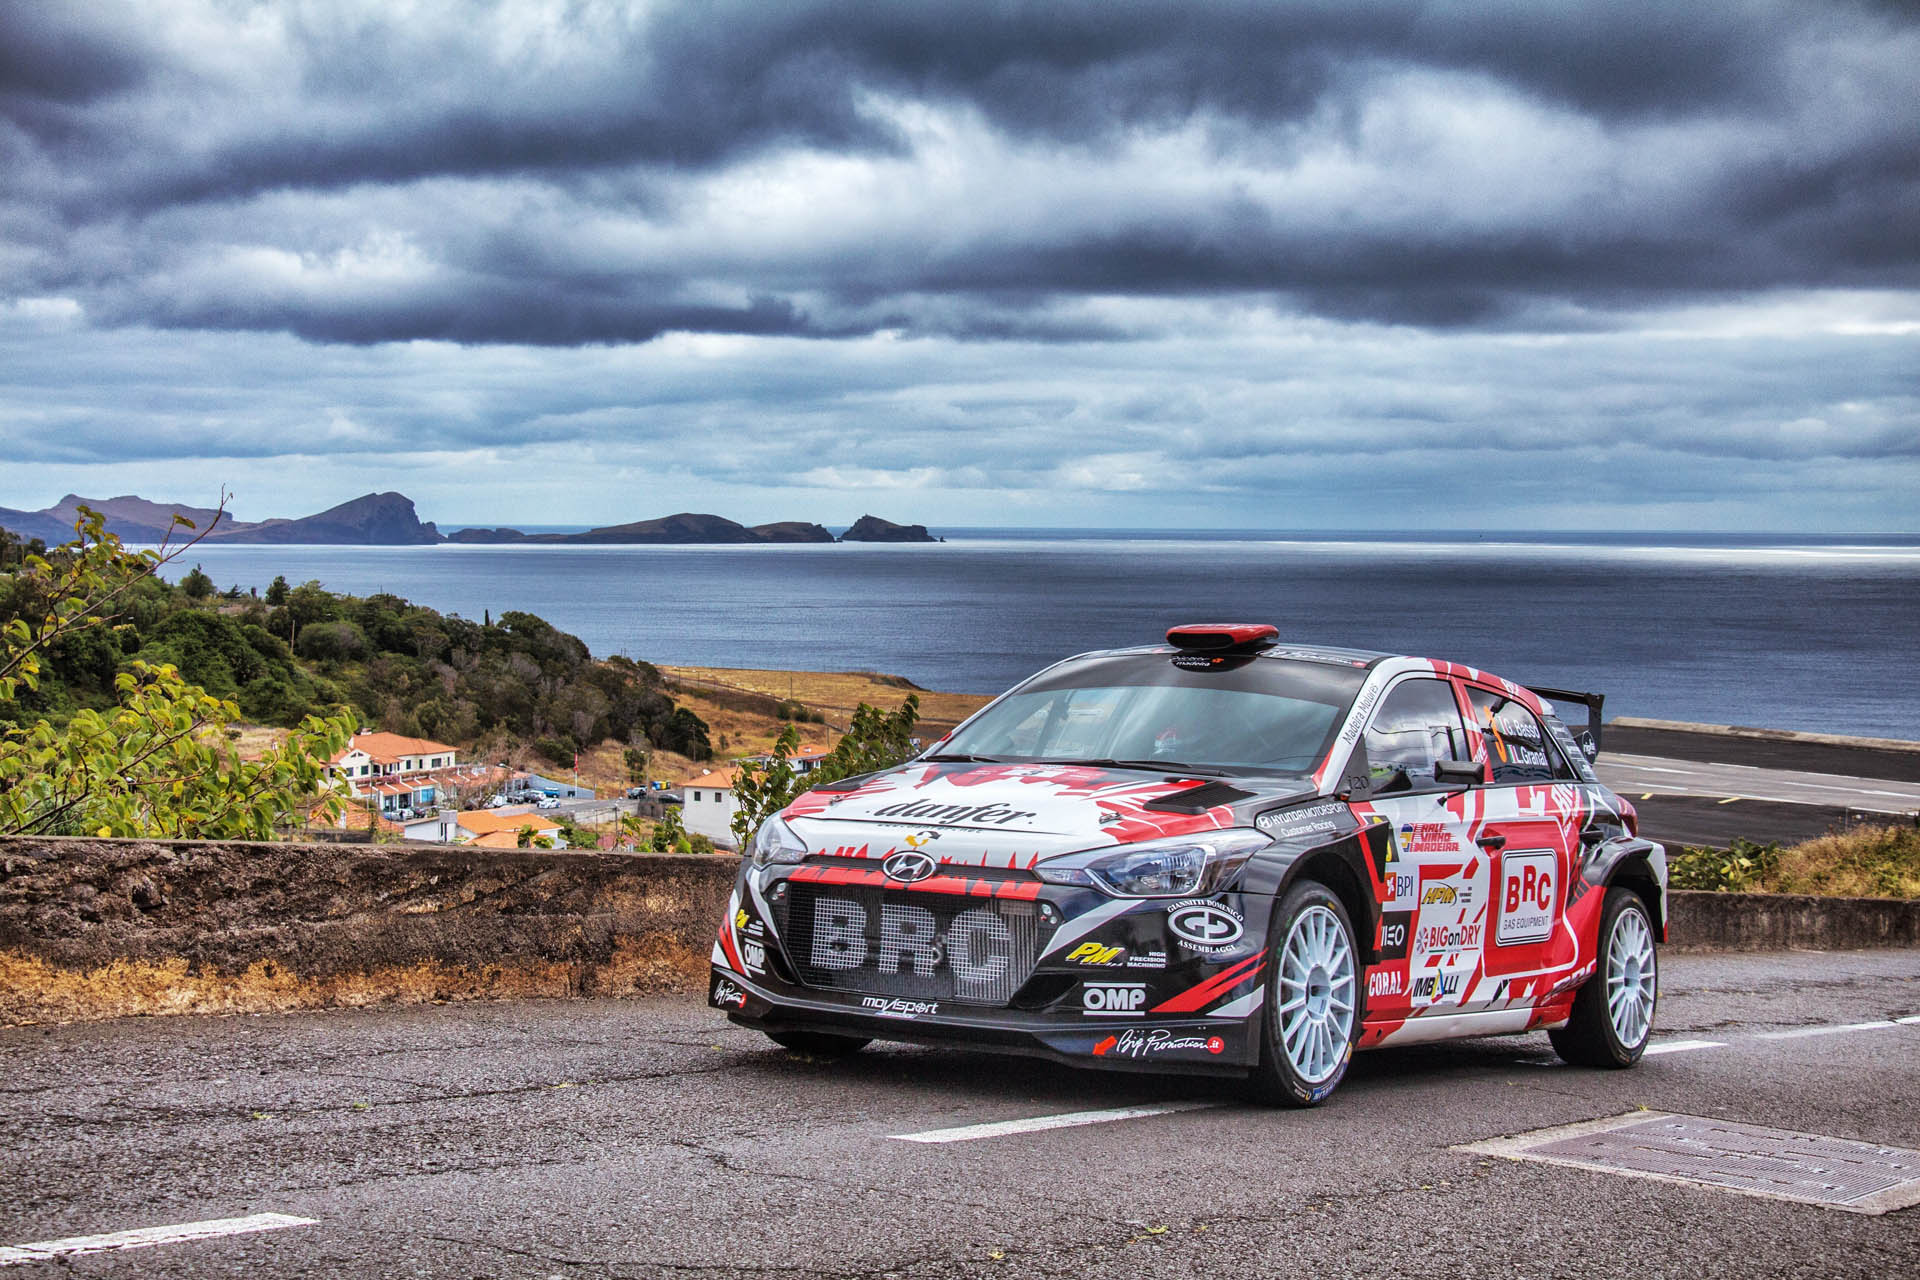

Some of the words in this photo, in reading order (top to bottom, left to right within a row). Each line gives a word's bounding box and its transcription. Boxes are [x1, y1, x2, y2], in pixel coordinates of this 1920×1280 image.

[1342, 711, 1365, 745] Madeira
[1357, 683, 1379, 714] Motores
[1513, 719, 1540, 738] Basso
[1347, 775, 1369, 790] i20
[873, 799, 1037, 825] danfer
[1270, 808, 1306, 825] HYUNDAI
[1303, 803, 1347, 818] MOTORSPORT
[1280, 823, 1315, 837] Customer
[1312, 819, 1337, 832] Racing
[1397, 875, 1414, 897] BPI
[1421, 887, 1458, 904] HPM
[1505, 865, 1551, 914] BRC
[1207, 899, 1244, 922] DOMENICO
[1503, 919, 1516, 930] GAS
[1516, 915, 1549, 928] EQUIPMENT
[810, 898, 1010, 983] BRC
[1177, 939, 1236, 953] ASSEMBLAGGI
[1429, 925, 1481, 947] BIGonDRY
[744, 944, 765, 968] OMP
[1369, 970, 1402, 997] CORAL
[862, 997, 939, 1014] movisport
[1083, 988, 1146, 1010] OMP
[1116, 1029, 1144, 1057] Big
[1142, 1029, 1208, 1056] Promotion
